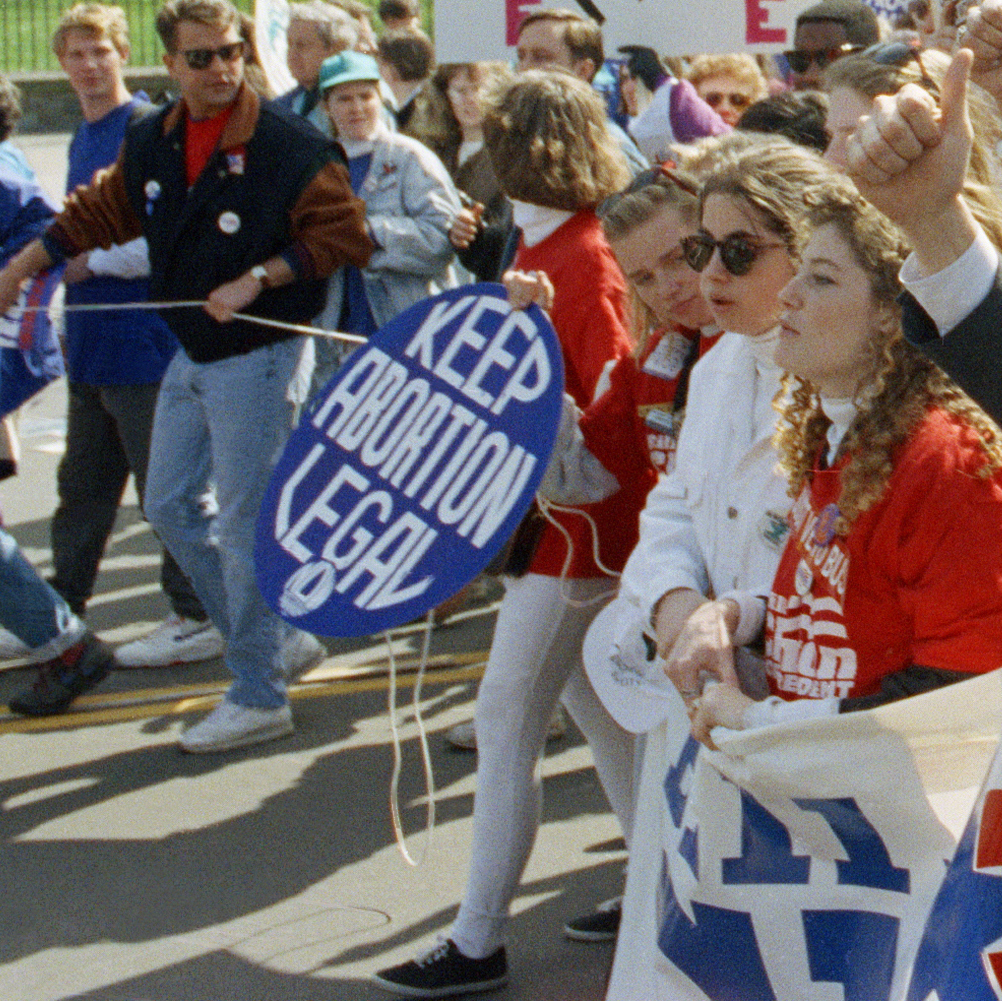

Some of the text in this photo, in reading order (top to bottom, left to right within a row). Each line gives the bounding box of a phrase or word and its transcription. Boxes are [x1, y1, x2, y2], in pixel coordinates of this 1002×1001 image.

[404, 295, 551, 415] KEEP
[275, 442, 439, 610] LEGAL
[312, 346, 537, 549] ABORTION
